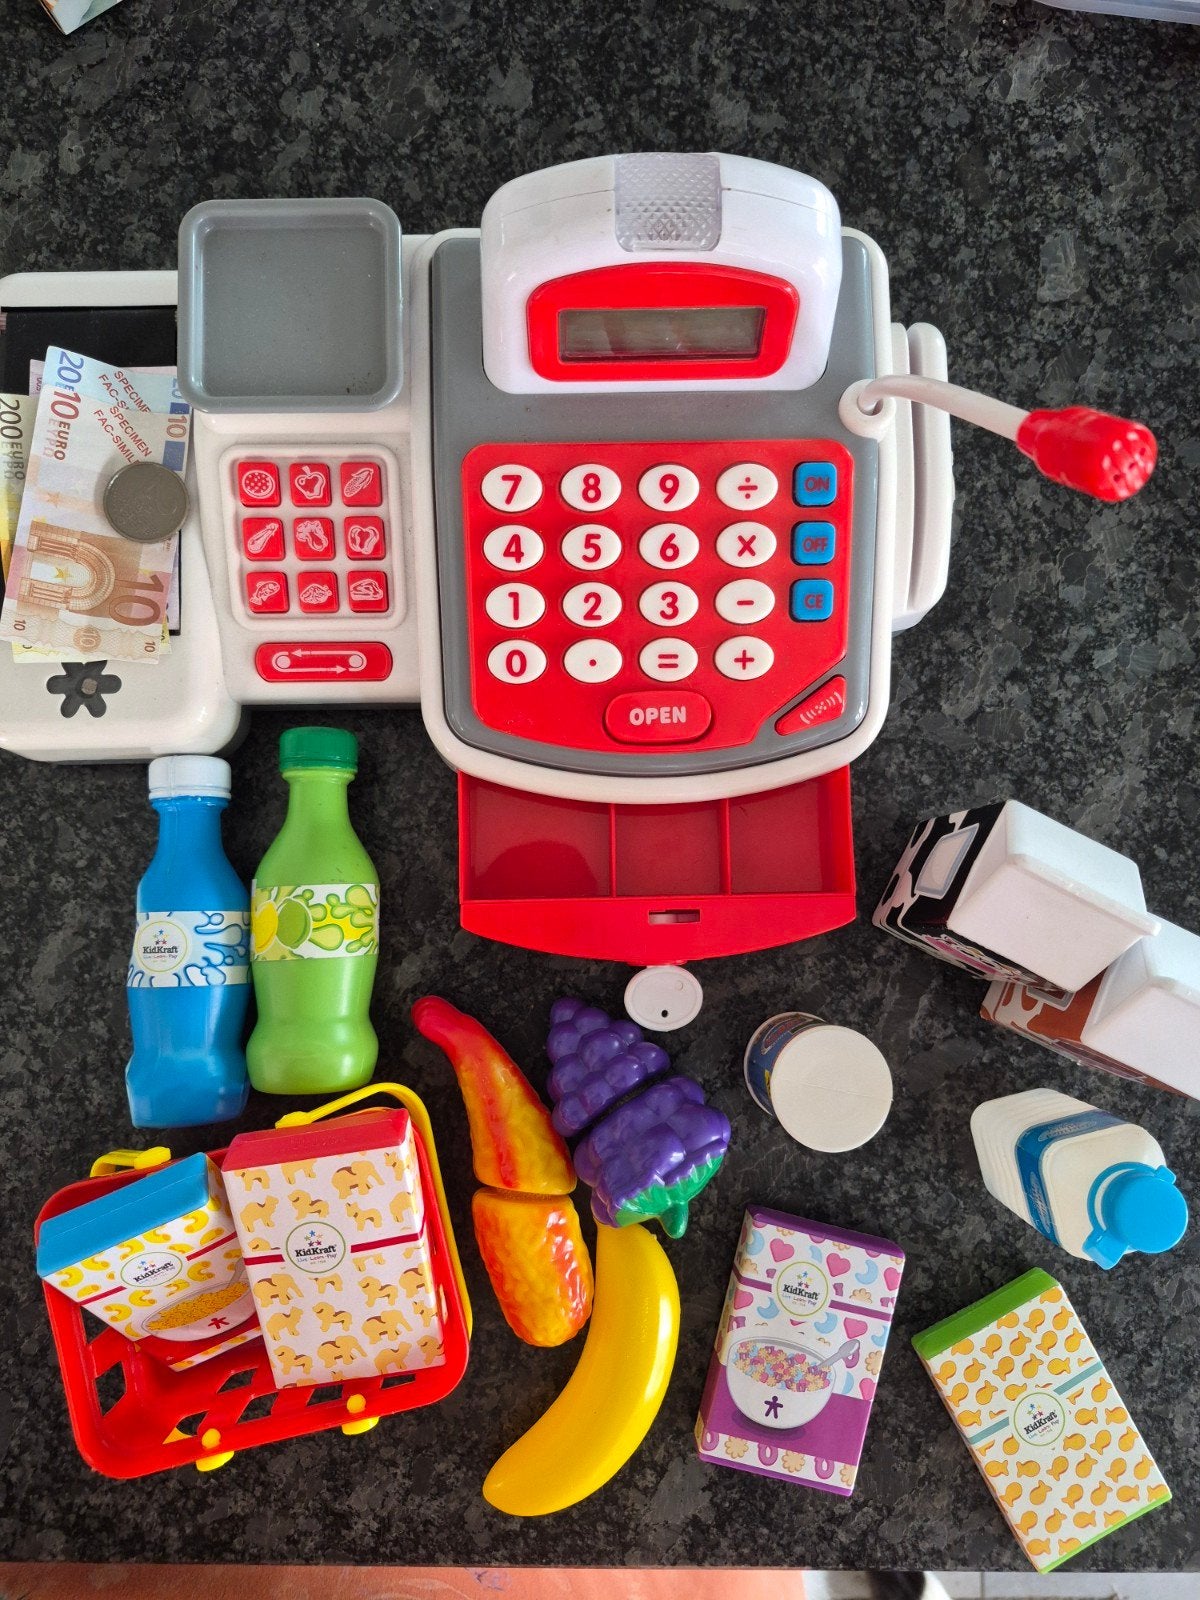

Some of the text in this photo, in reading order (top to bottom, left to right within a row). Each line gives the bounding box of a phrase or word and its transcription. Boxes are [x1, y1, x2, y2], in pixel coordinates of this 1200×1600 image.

[57, 350, 85, 384] 20
[50, 390, 82, 420] 10
[0, 397, 26, 481] 200 EURO
[109, 405, 153, 458] SPECIMEN
[166, 415, 188, 439] 10
[53, 420, 71, 461] EURO
[501, 474, 522, 505] 7
[582, 473, 601, 504] 8
[659, 473, 680, 504] 9
[804, 476, 830, 492] ON
[503, 533, 525, 563] 4
[582, 533, 601, 563] 5
[659, 533, 680, 562] 6
[802, 537, 828, 553] OFF
[109, 574, 164, 626] 10
[508, 591, 520, 620] 1
[583, 592, 602, 621] 2
[660, 591, 679, 620] 3
[804, 594, 824, 609] CE
[13, 619, 26, 631] 10
[144, 641, 156, 653] 10
[505, 649, 527, 677] 0
[629, 706, 687, 726] OPEN
[143, 946, 178, 954] KidKraft
[295, 1245, 336, 1257] KidKraft
[133, 1262, 174, 1282] KidKraft
[783, 1284, 818, 1301] KidKraft
[1024, 1411, 1057, 1435] KidKraft
